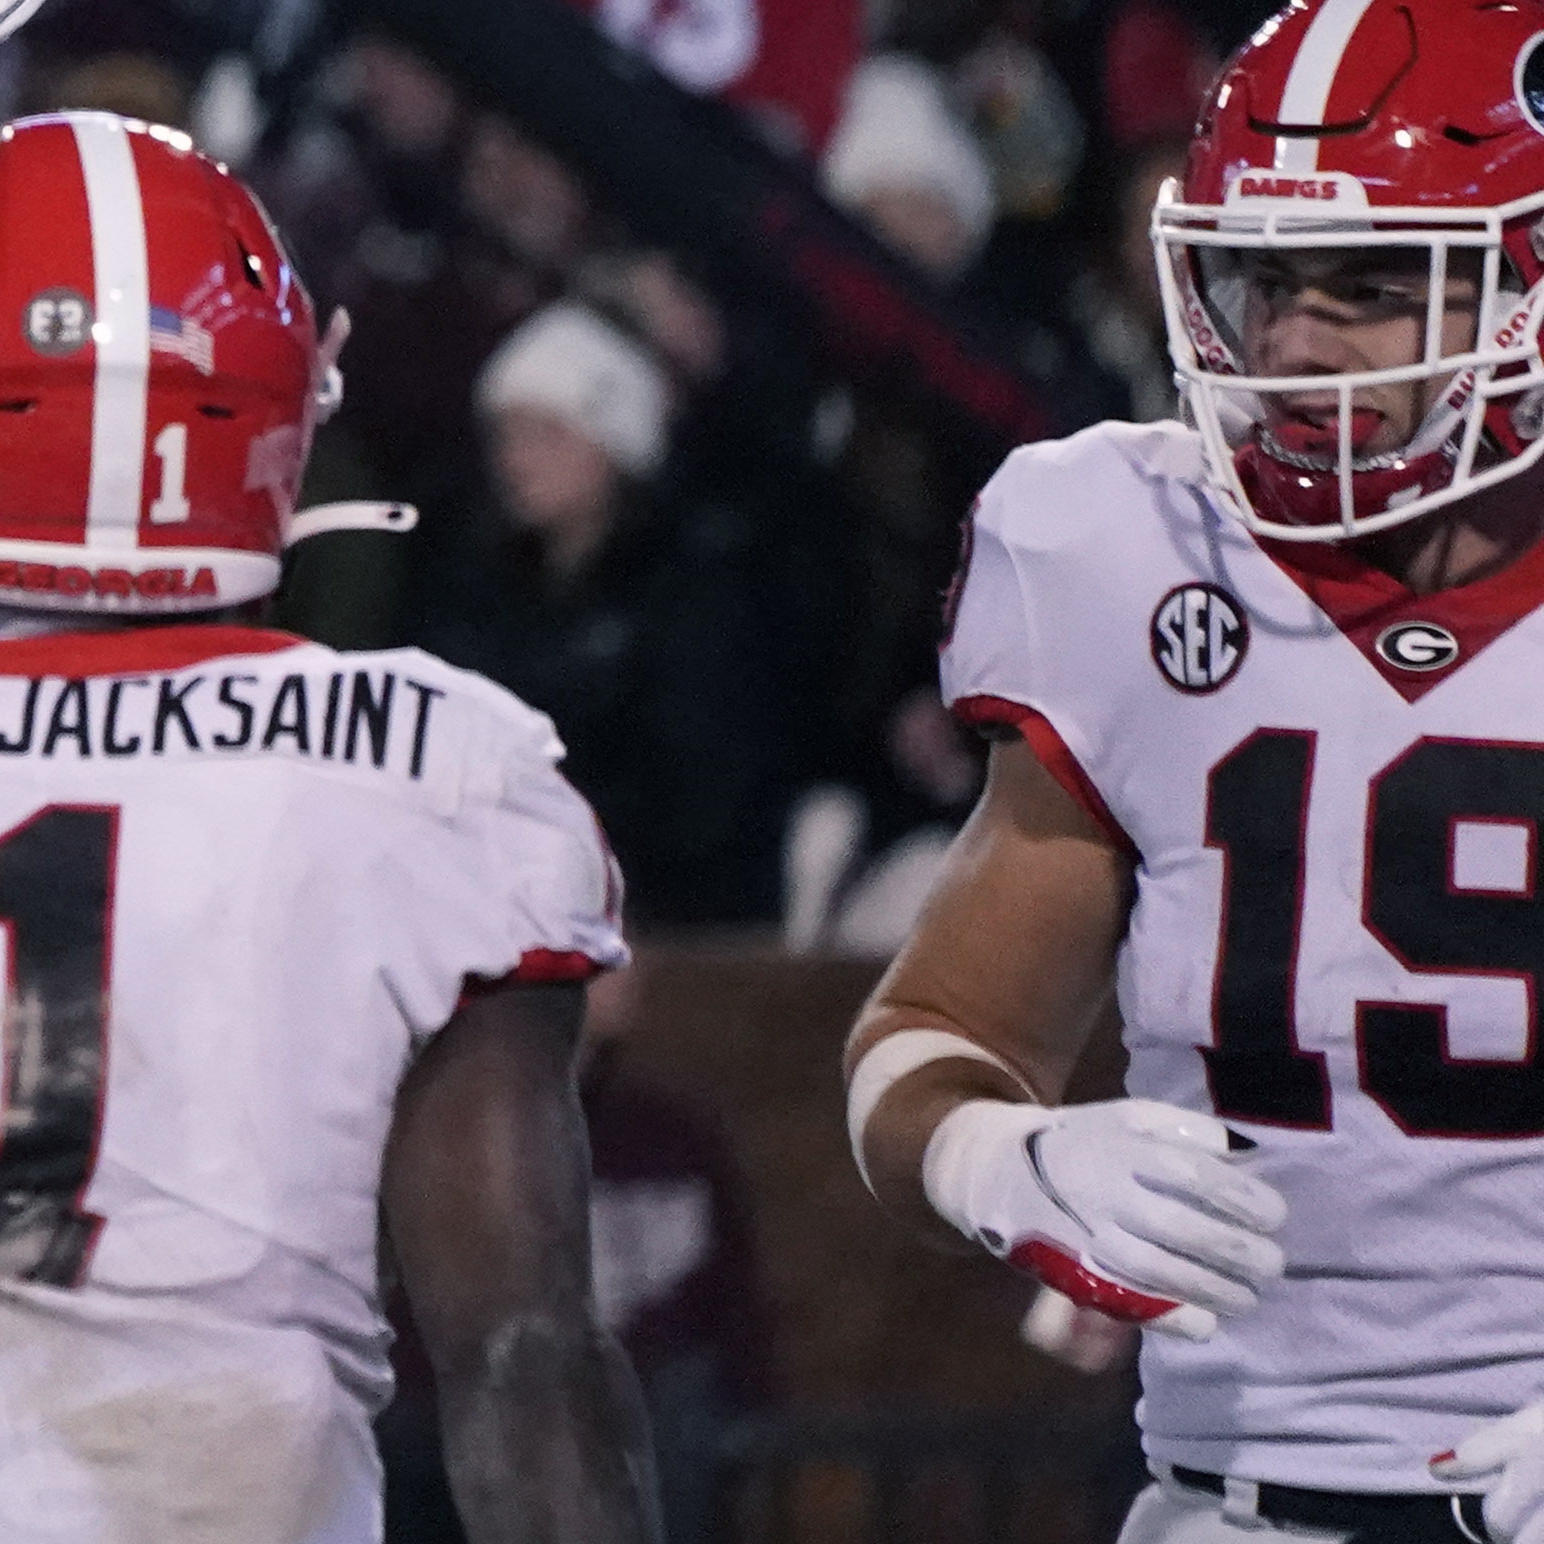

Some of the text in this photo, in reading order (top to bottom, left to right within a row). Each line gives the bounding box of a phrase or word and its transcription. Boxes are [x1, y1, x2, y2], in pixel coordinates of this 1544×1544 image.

[1240, 177, 1338, 200] DAWGS
[150, 422, 190, 524] 1
[1157, 587, 1239, 687] SEC
[1382, 625, 1455, 668] G
[1194, 726, 1544, 1139] 19
